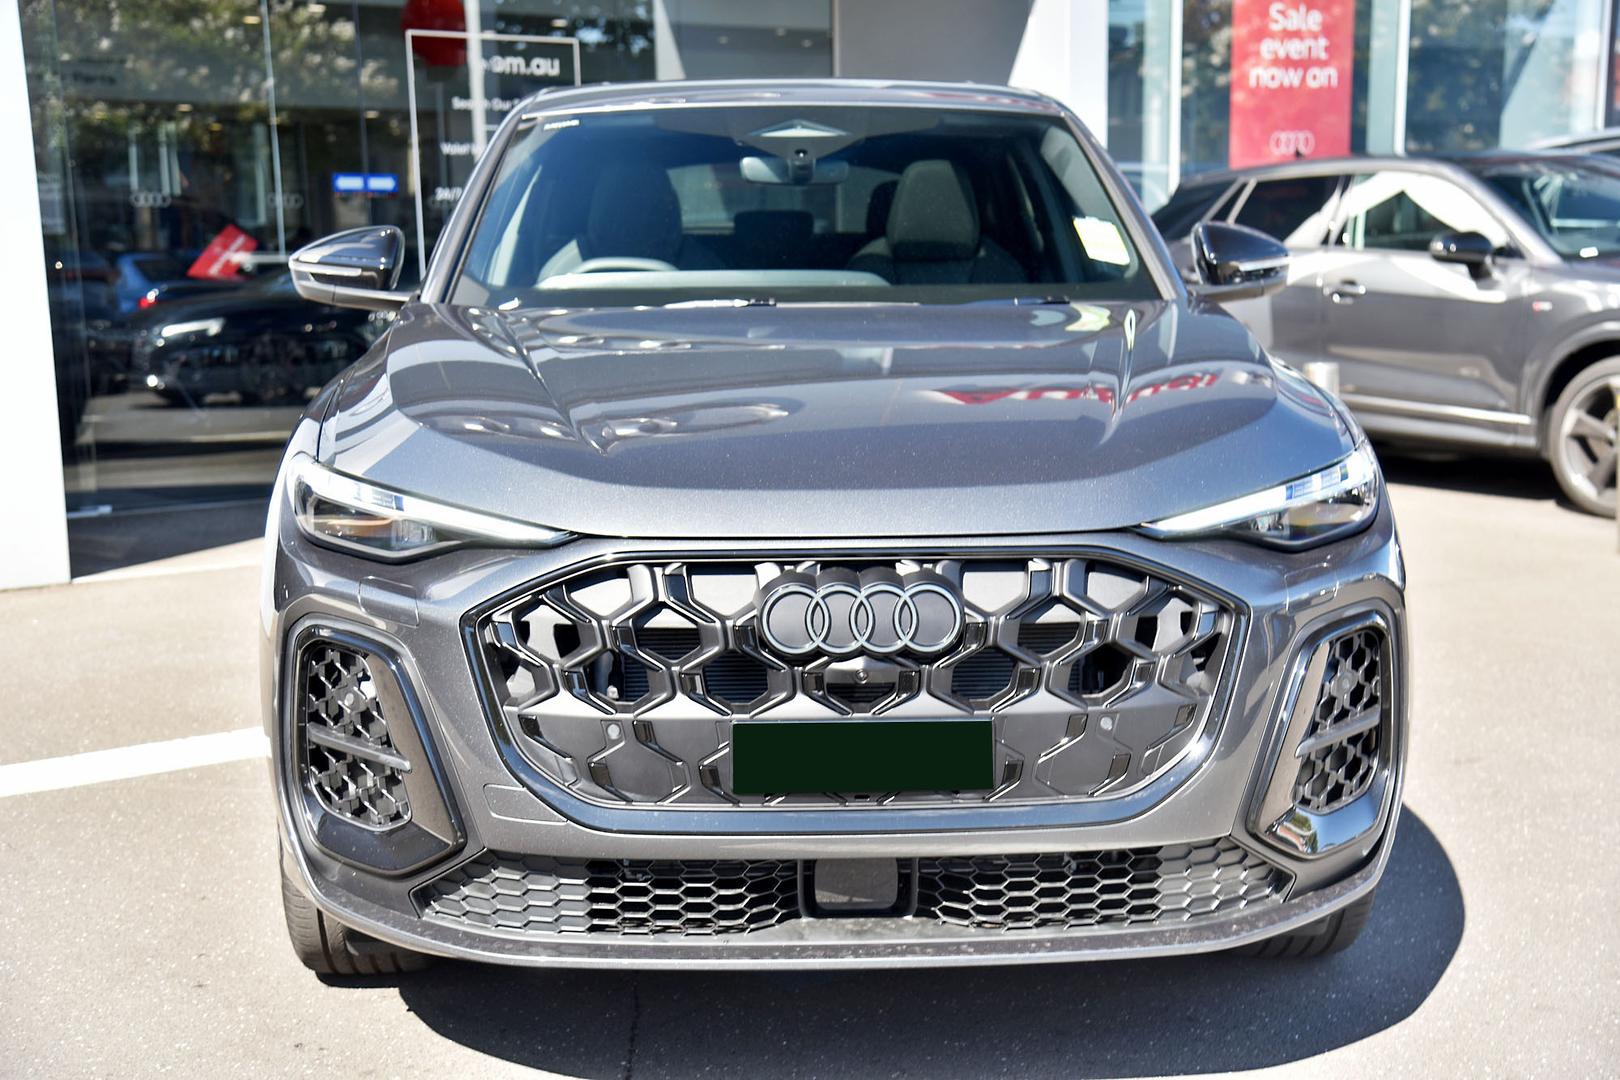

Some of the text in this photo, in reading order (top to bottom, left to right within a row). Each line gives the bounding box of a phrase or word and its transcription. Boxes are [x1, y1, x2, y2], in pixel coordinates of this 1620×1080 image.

[1268, 2, 1322, 31] Sale
[1260, 36, 1329, 60] event
[1249, 66, 1338, 88] now on
